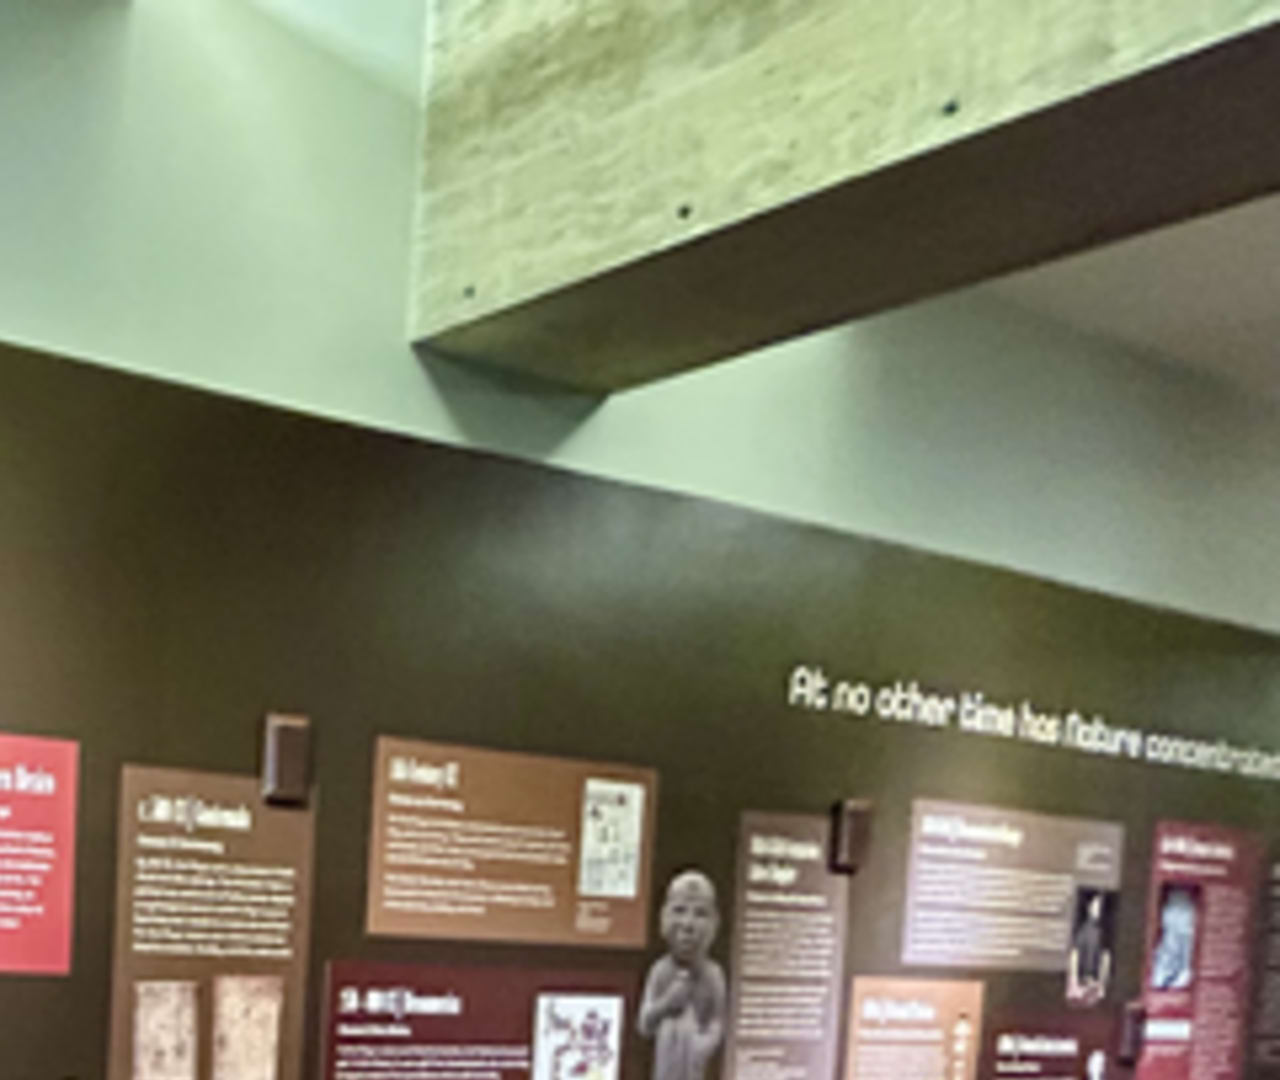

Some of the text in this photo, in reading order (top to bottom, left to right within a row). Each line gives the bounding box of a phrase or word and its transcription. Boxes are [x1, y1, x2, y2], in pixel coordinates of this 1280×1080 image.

[787, 665, 828, 710] At
[831, 678, 871, 716] no
[874, 680, 956, 728] other
[958, 691, 1016, 738] time
[1018, 700, 1062, 745] has
